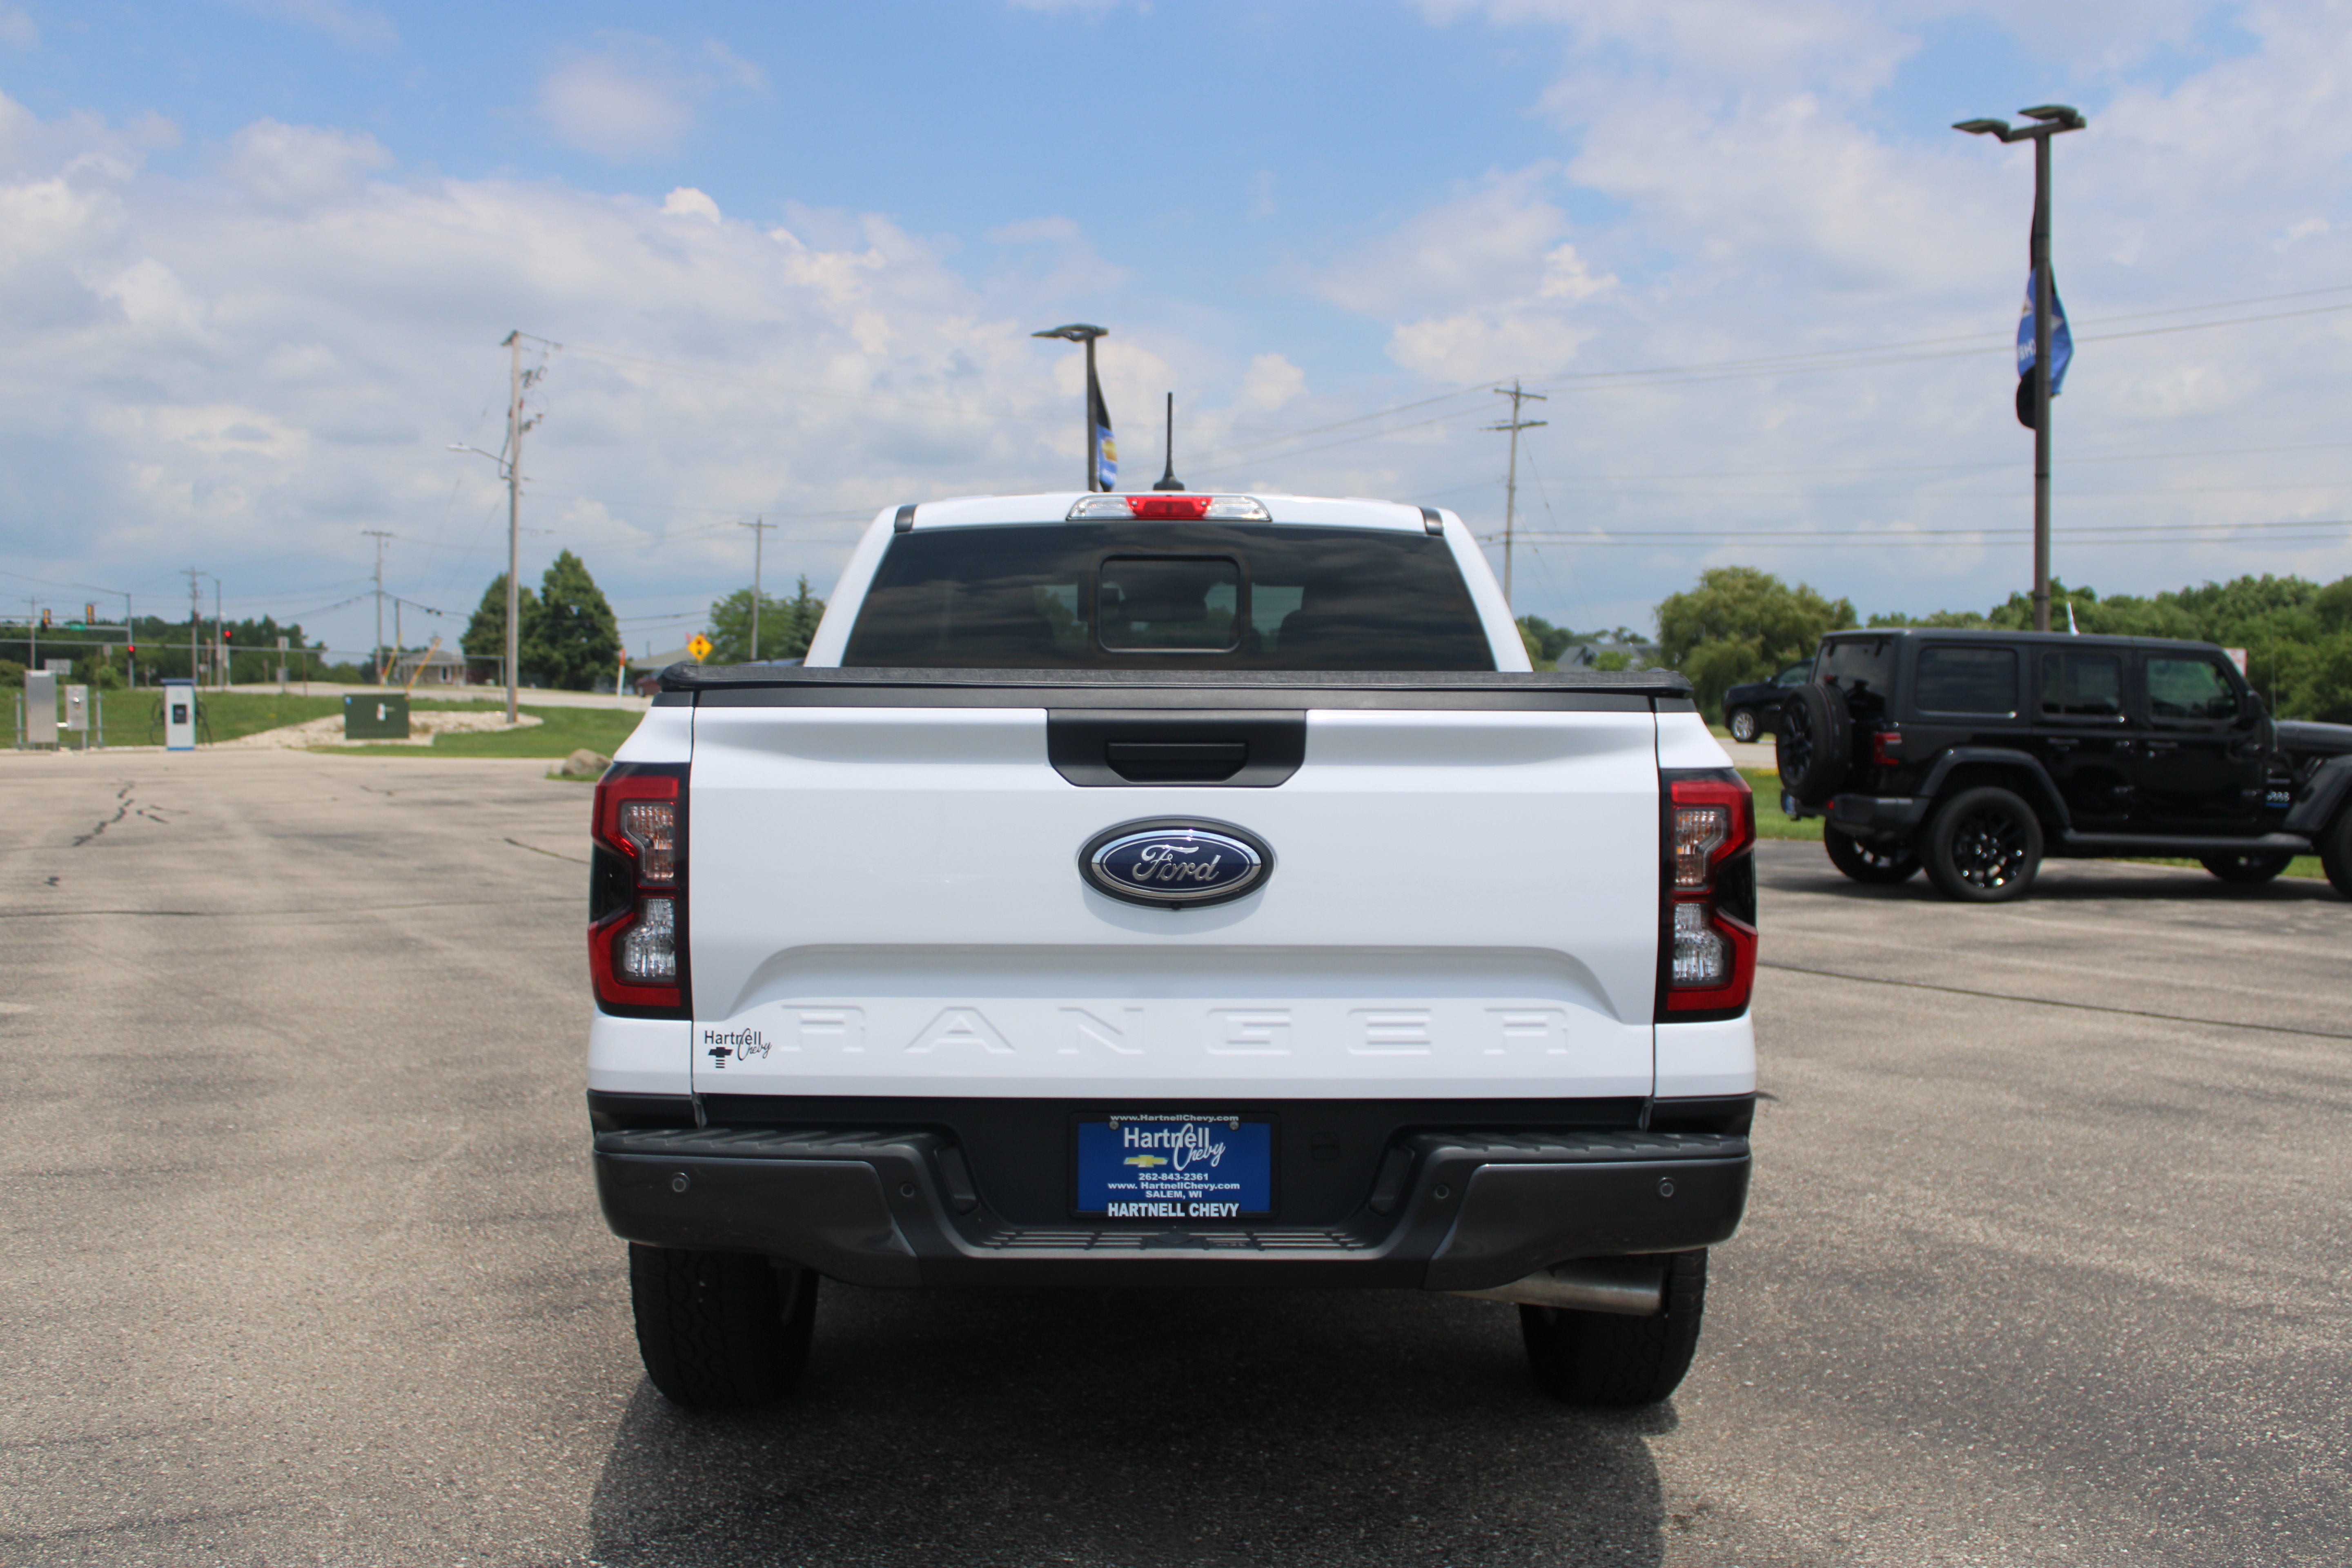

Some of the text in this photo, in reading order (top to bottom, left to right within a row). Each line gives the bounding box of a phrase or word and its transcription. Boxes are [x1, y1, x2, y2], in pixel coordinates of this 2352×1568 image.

[1132, 844, 1221, 881] Ford
[704, 1030, 761, 1045] Hartnell
[780, 1005, 1568, 1054] RANGER
[737, 1028, 772, 1061] Chevy
[1124, 1127, 1209, 1148] Hartnell
[1173, 1123, 1226, 1171] Chevy
[1141, 1182, 1240, 1191] HartnellChevy.com
[1145, 1191, 1186, 1199] SALEM,
[1107, 1203, 1239, 1217] HARTNELL CHEVY
